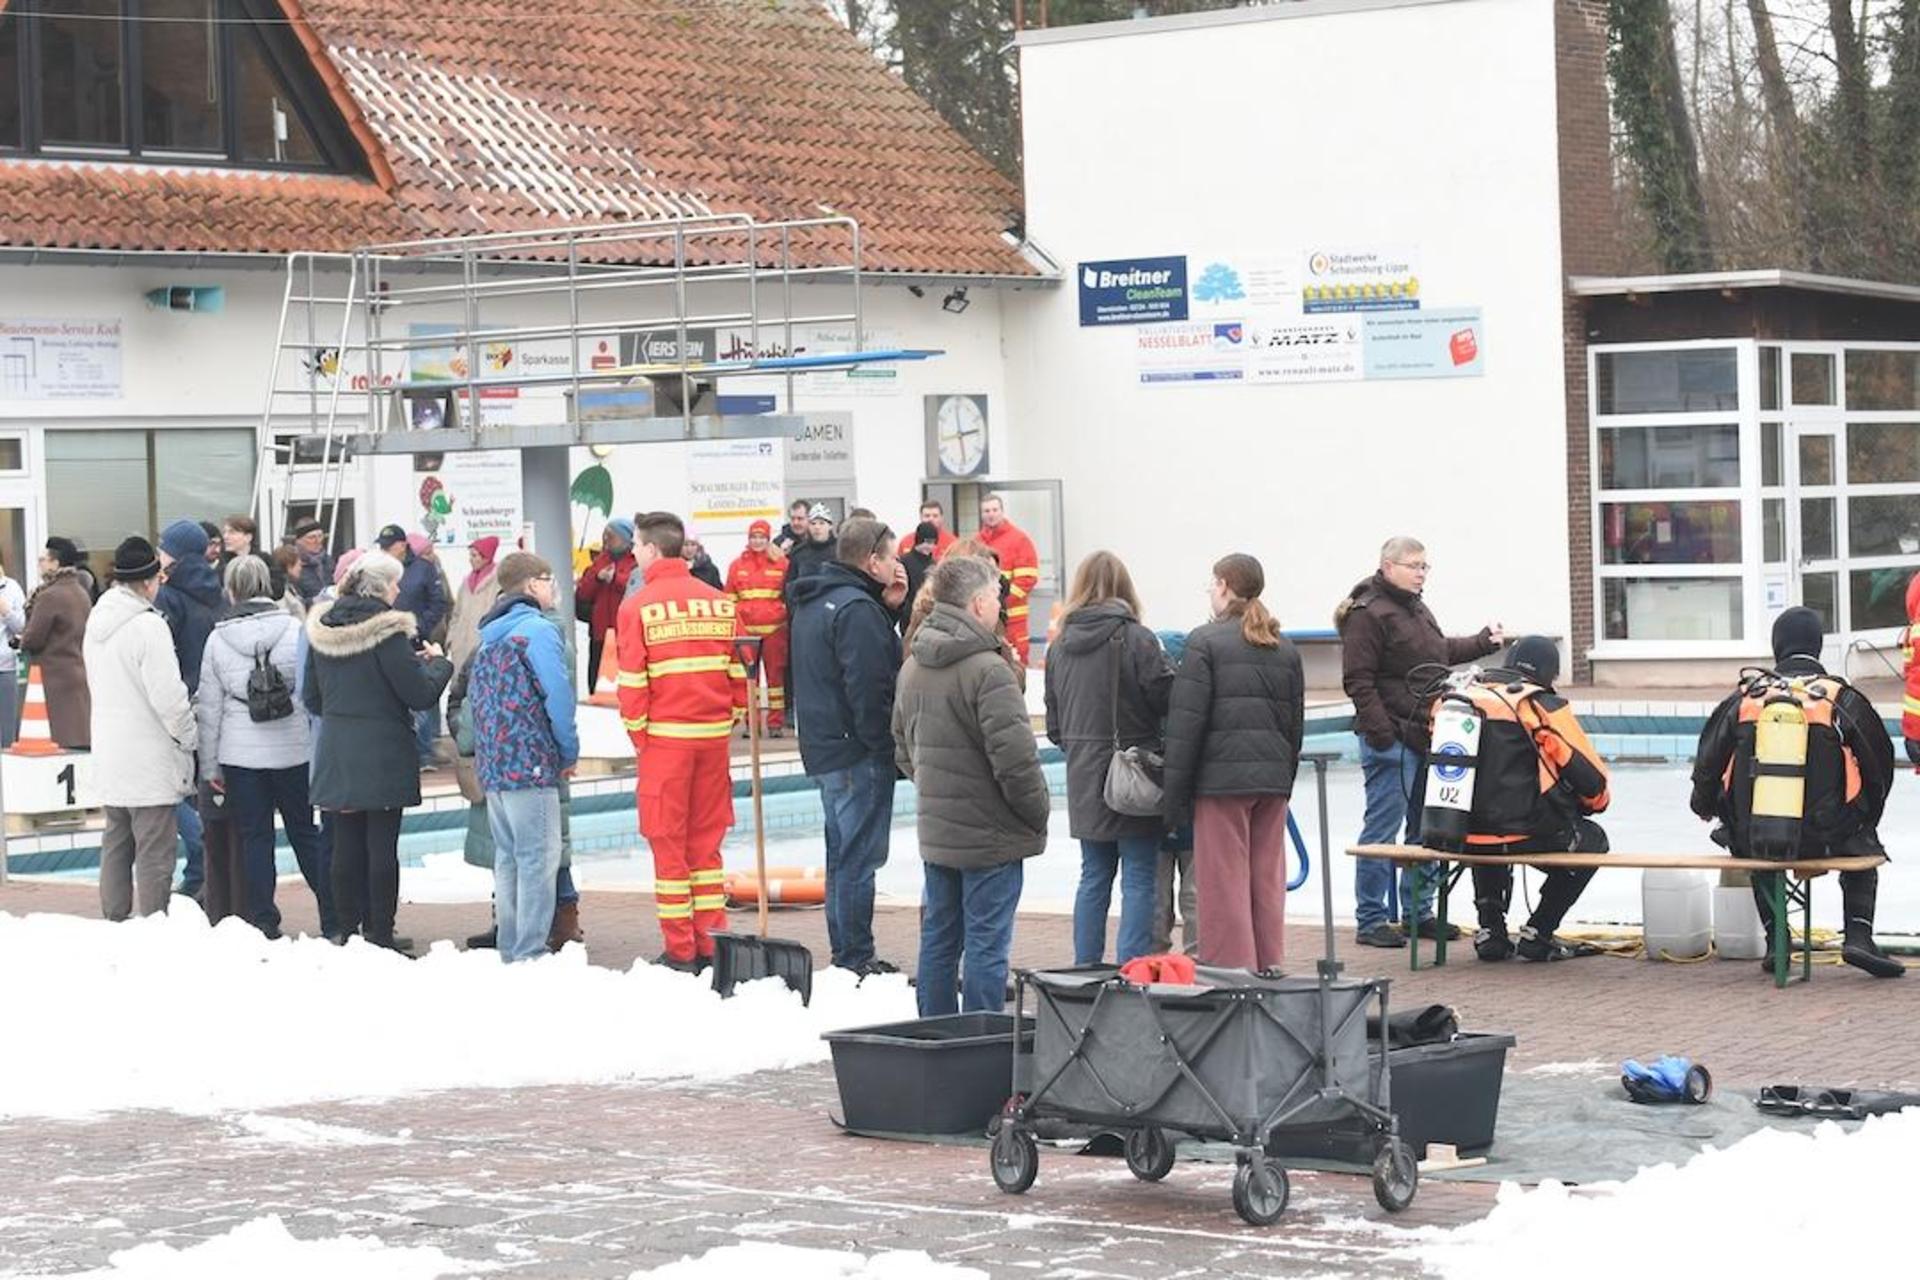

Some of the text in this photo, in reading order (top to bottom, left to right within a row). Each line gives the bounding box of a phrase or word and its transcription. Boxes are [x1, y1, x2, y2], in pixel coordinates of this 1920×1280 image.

[1099, 267, 1171, 289] Breitner
[1126, 287, 1183, 301] CleanTeam
[632, 331, 705, 366] KIERSEIN
[1138, 333, 1213, 349] NESSELBLATT
[1268, 333, 1338, 346] MATZ
[521, 353, 570, 366] Sparkasse
[795, 424, 844, 442] AMEN
[640, 599, 736, 622] DLRG
[57, 763, 76, 806] 1
